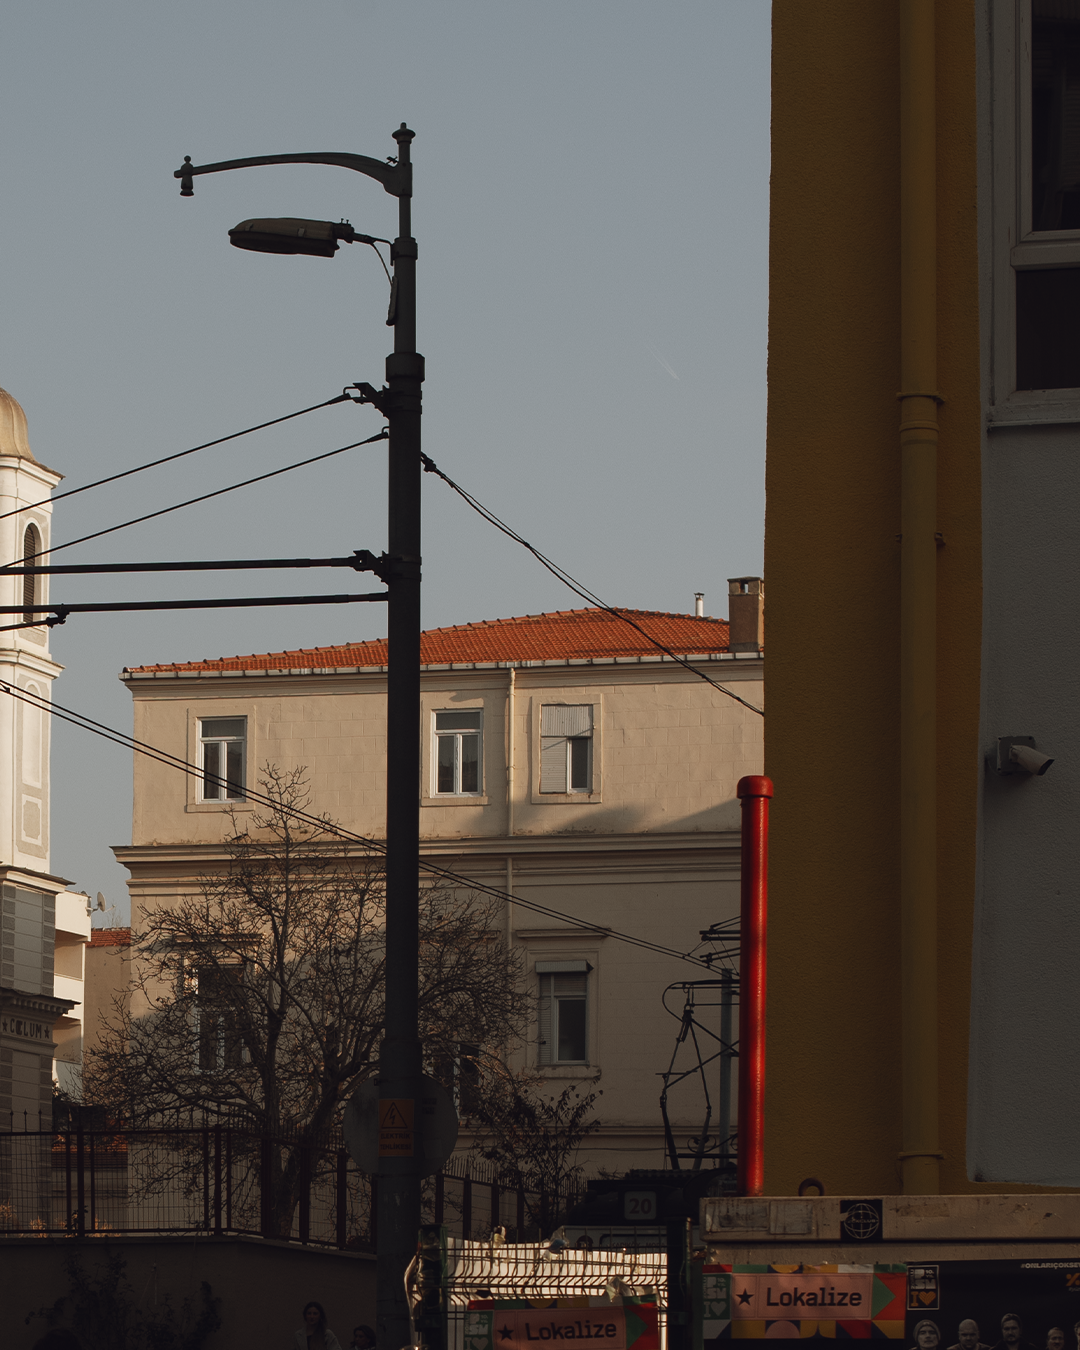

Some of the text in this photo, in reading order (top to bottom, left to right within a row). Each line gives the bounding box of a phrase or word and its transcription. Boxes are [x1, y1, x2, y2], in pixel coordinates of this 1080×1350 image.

[629, 1198, 652, 1214] 20
[766, 1287, 863, 1306] Lokalize
[525, 1320, 617, 1341] Lokalize
